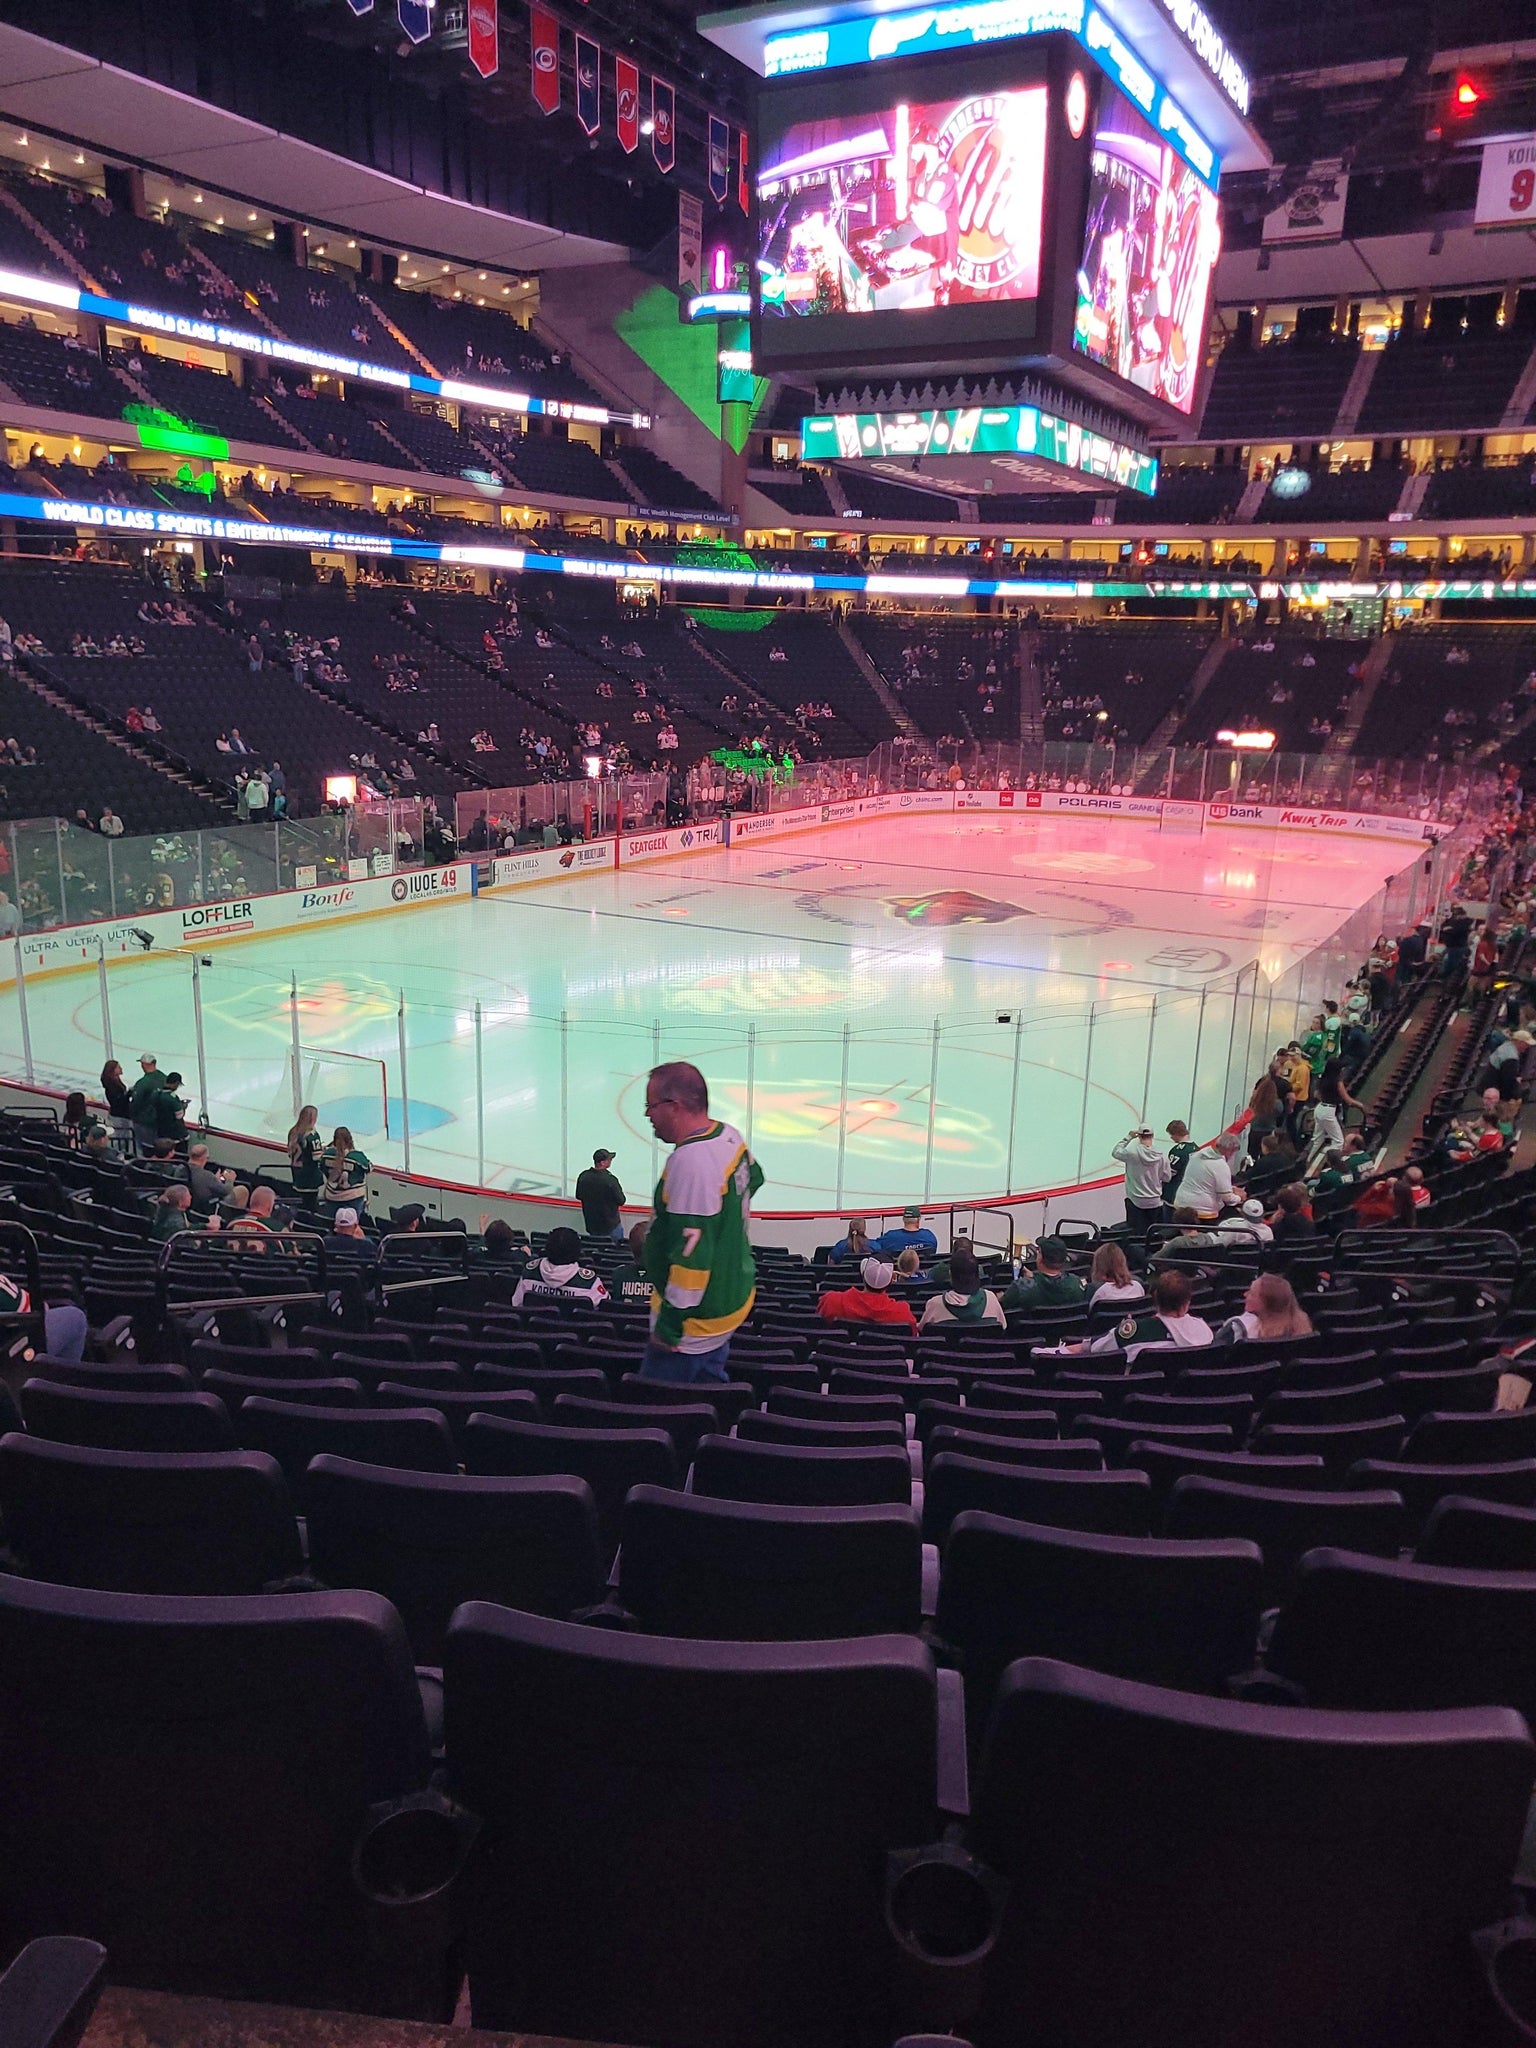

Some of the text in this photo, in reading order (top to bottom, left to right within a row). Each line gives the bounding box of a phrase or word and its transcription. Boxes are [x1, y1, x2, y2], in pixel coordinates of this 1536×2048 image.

[651, 509, 669, 517] Wealth
[670, 511, 703, 520] Management
[43, 501, 104, 525] WORLD
[105, 508, 154, 530] CLASS
[157, 514, 213, 536] SPORTS
[213, 521, 225, 537] &
[226, 522, 331, 547] ENTERTAINMENT
[1058, 797, 1122, 809] POLARIS
[1128, 803, 1155, 812] GRAND
[1229, 806, 1263, 819] bank
[748, 818, 775, 830] ANDERSEN
[629, 836, 668, 856] SEATGEEK
[504, 862, 521, 873] FLINT
[522, 859, 539, 870] HILLS
[410, 869, 457, 894] IUOE 49
[145, 893, 154, 905] 9
[302, 887, 354, 909] Bonfe
[182, 902, 252, 927] LOFFLER
[107, 928, 134, 942] ULTR
[24, 941, 59, 954] ULTRA
[66, 937, 98, 947] ULTRA
[311, 1139, 321, 1151] 12
[682, 1228, 702, 1257] 7
[622, 1282, 654, 1296] HUGHE
